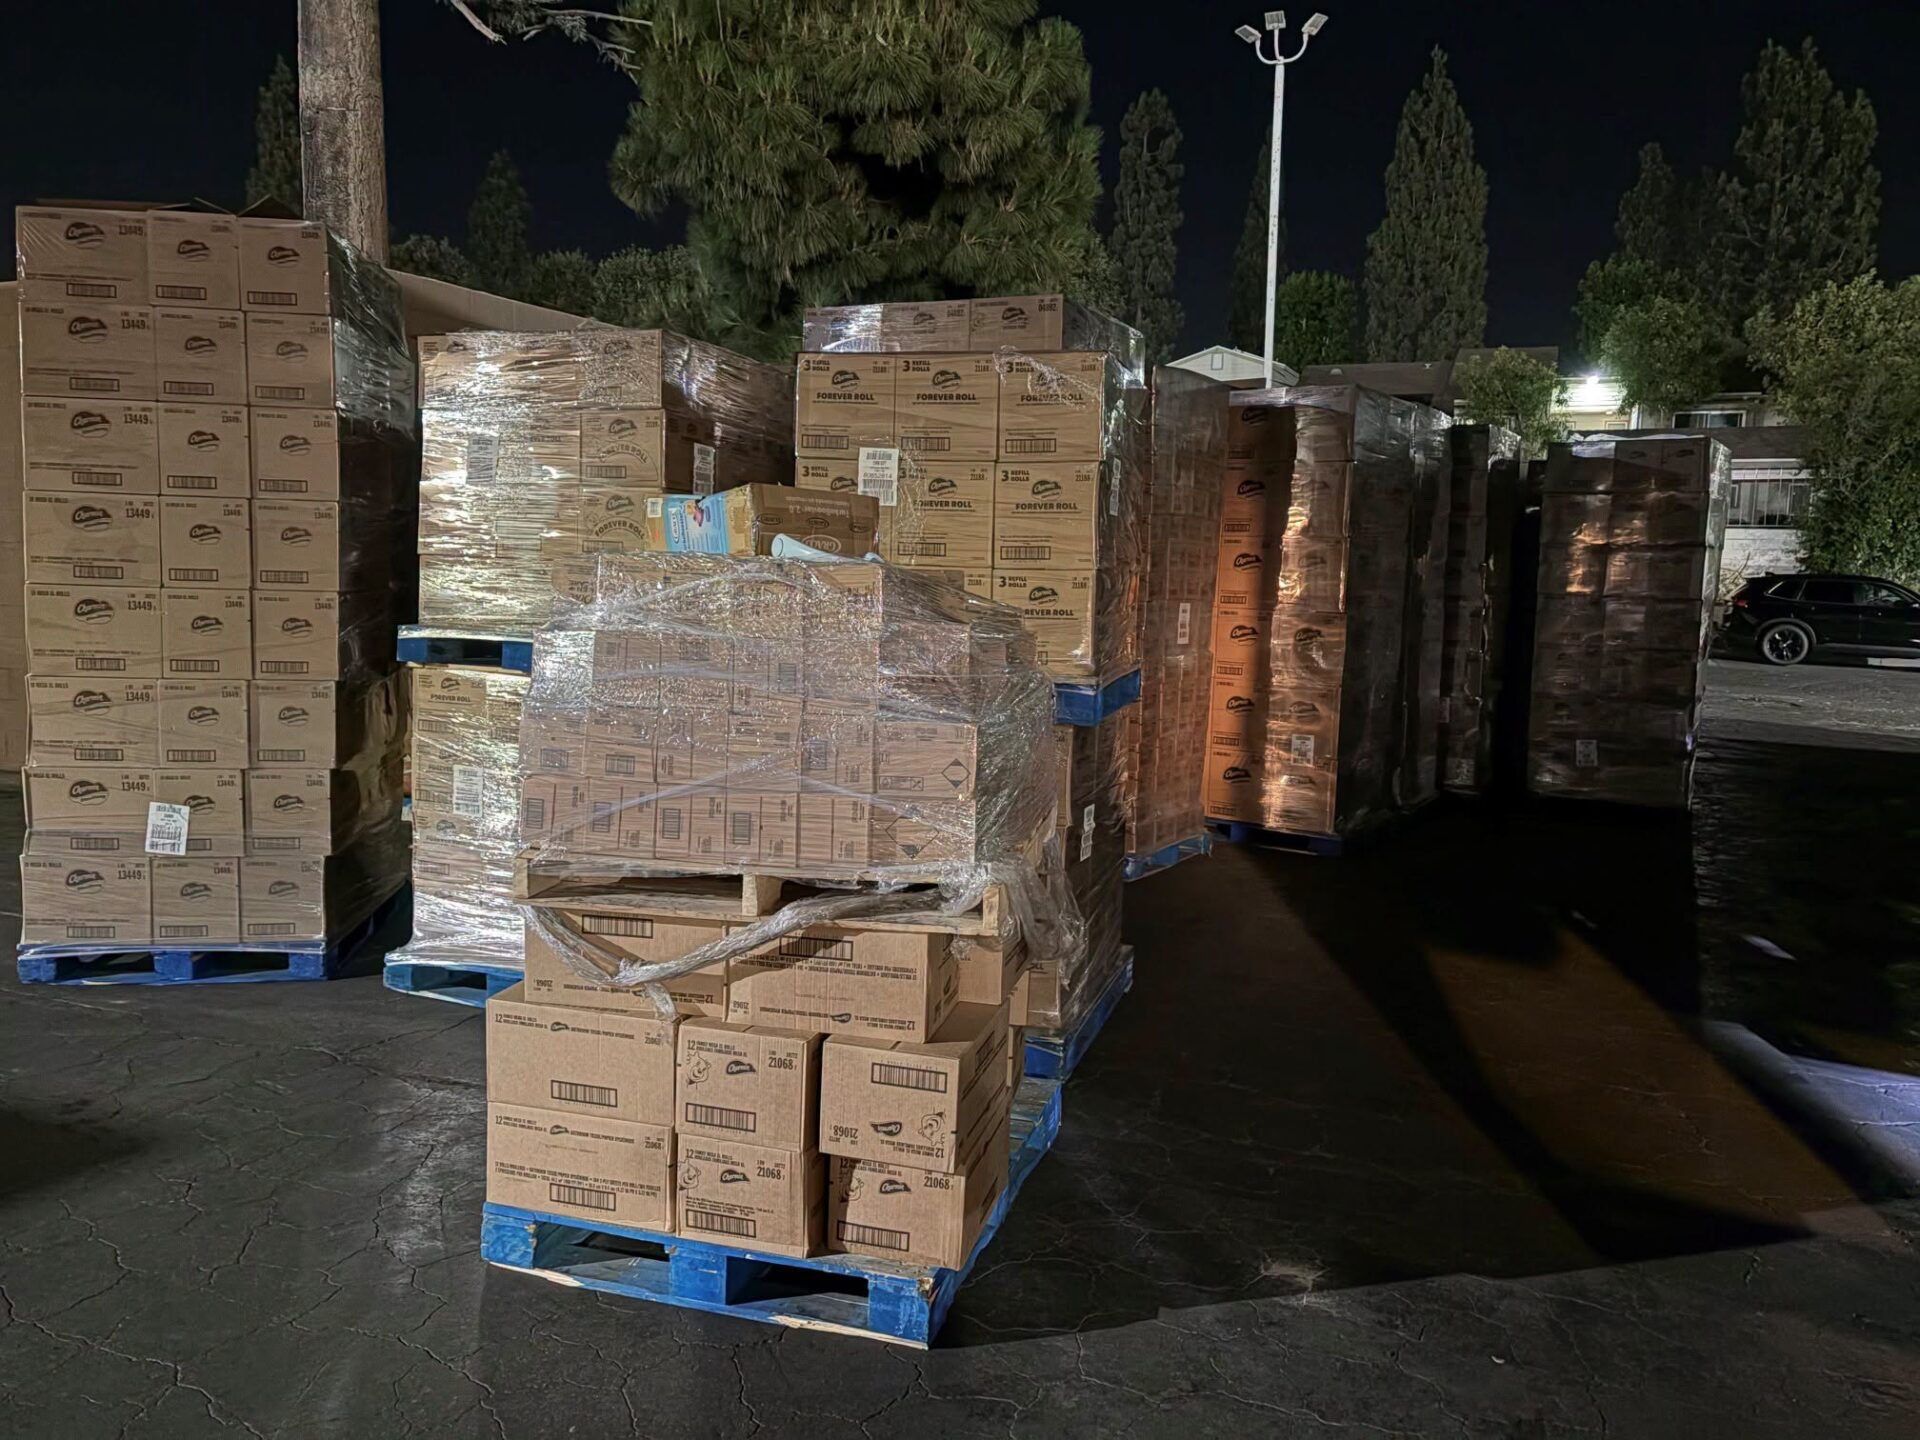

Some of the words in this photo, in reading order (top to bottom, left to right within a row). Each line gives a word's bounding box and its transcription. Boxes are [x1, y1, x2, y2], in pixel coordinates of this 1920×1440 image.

[803, 359, 811, 371] 3
[902, 360, 910, 372] 3
[1006, 361, 1014, 373] 3
[816, 392, 853, 400] FOREVER
[854, 393, 875, 401] ROLL
[802, 465, 810, 477] 3
[1001, 470, 1009, 482] 3
[1015, 502, 1055, 510] FOREVER
[1056, 502, 1078, 510] ROLL
[125, 508, 150, 519] 13449
[594, 520, 628, 538] FOREVER
[628, 522, 646, 540] ROLL
[999, 576, 1007, 588] 3
[127, 600, 153, 611] 13449
[125, 691, 150, 702] 13449
[121, 781, 146, 792] 13449
[117, 870, 142, 880] 13449
[704, 994, 714, 1004] 12
[495, 1013, 502, 1023] 12
[907, 1020, 916, 1031] 12
[687, 1040, 696, 1050] 12
[768, 1056, 794, 1070] 21068
[495, 1115, 502, 1125] 12
[833, 1124, 858, 1139] 21068
[686, 1148, 694, 1159] 12
[935, 1147, 944, 1159] 12
[840, 1158, 848, 1168] 12
[757, 1166, 782, 1180] 21068
[924, 1176, 950, 1190] 21068
